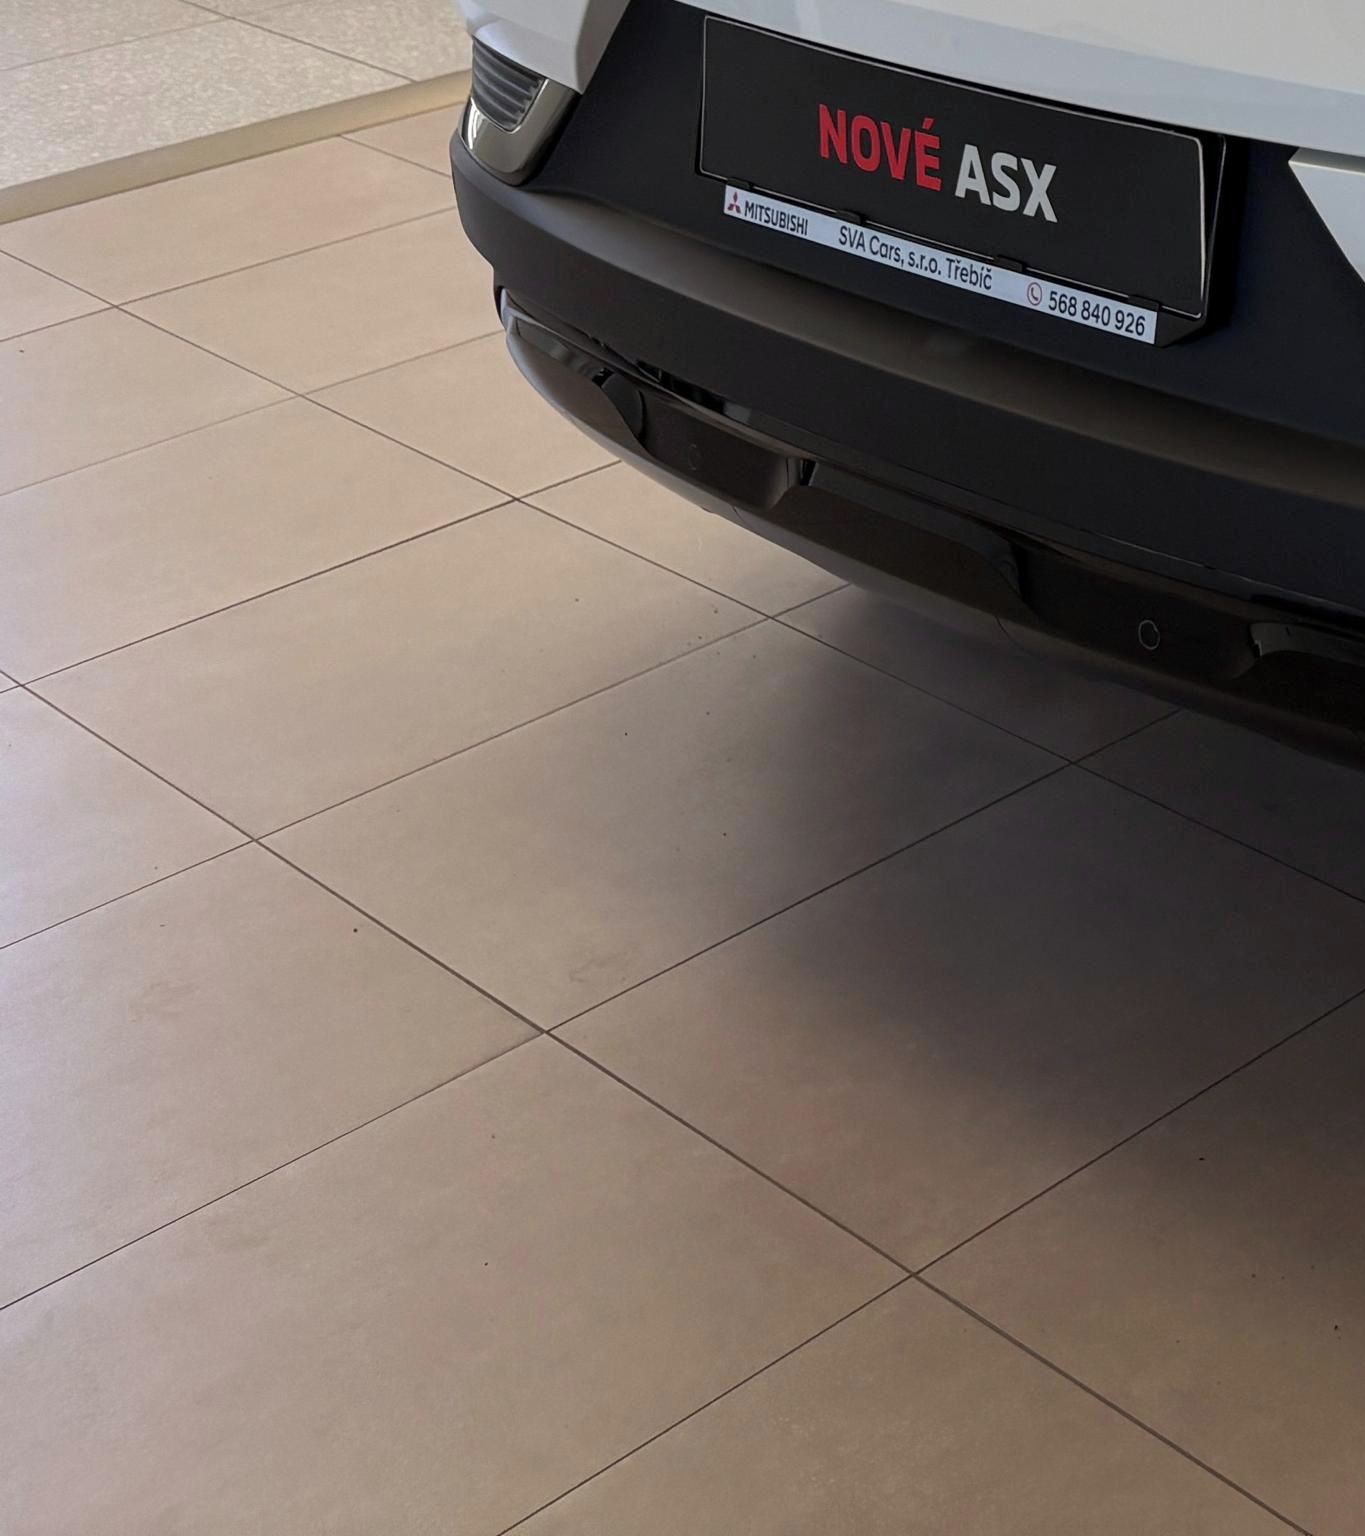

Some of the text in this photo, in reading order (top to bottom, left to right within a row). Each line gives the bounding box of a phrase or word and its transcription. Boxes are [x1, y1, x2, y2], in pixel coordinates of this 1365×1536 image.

[818, 102, 1058, 224] NOVÉ ASX
[744, 200, 1147, 337] MITSUBISHI SVA Cars, s.r.o. Třebíč 568 840 926
